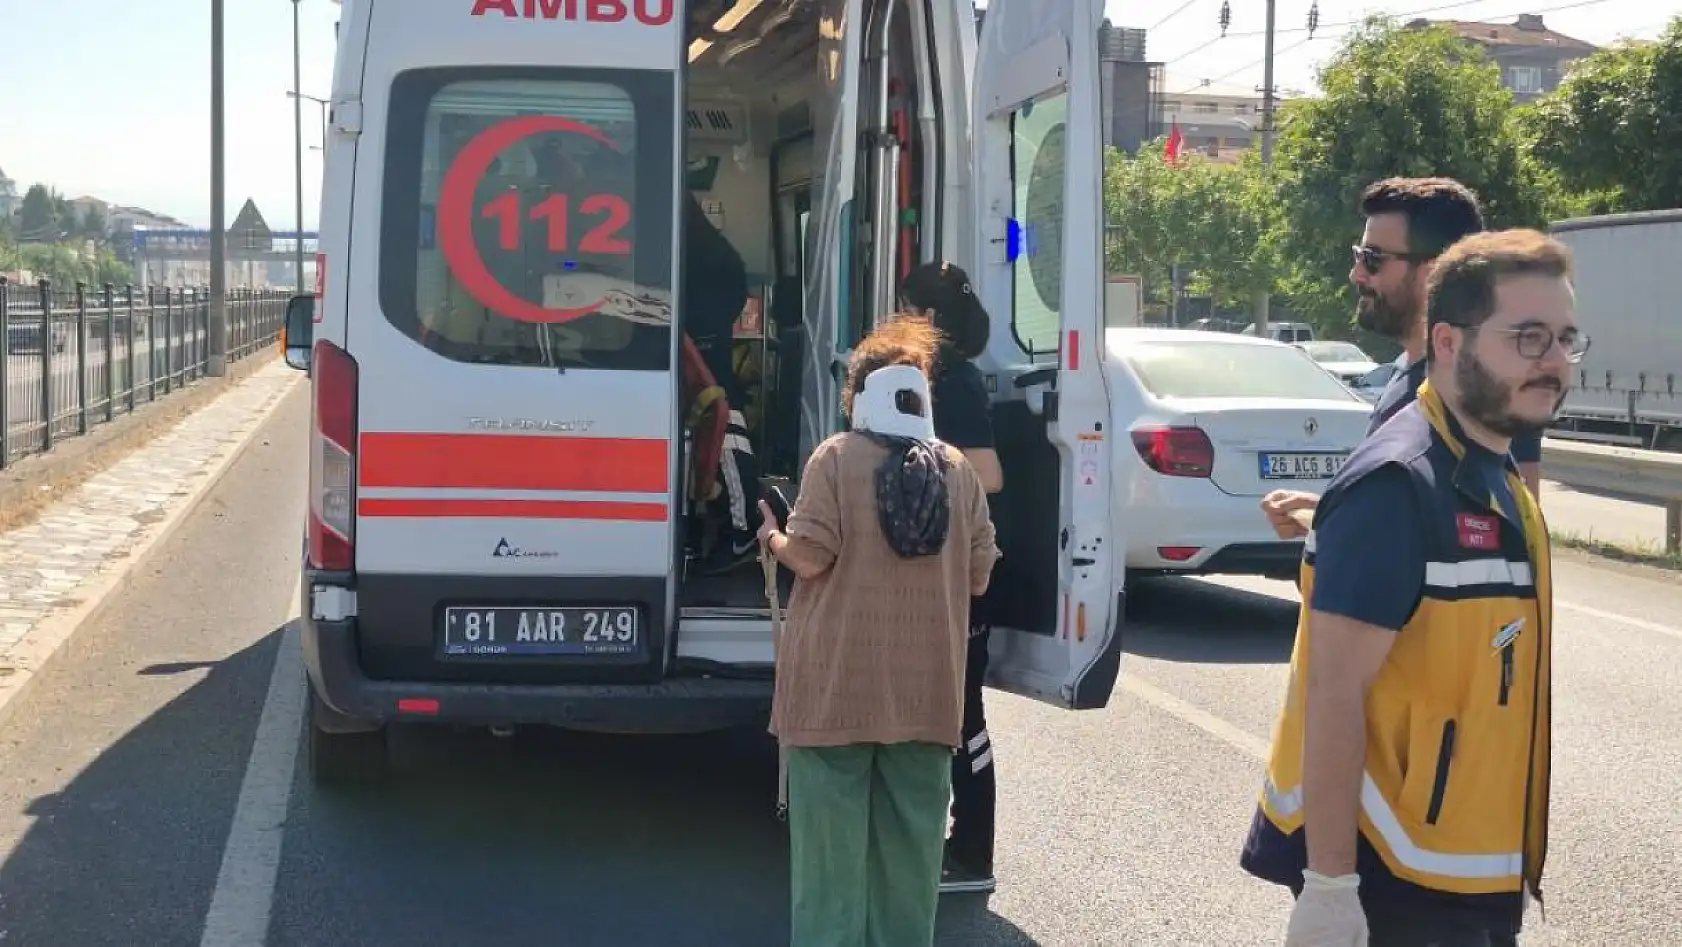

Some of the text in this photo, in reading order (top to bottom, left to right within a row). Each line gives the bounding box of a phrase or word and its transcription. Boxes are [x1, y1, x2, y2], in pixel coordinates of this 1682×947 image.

[481, 192, 632, 254] 112
[1271, 457, 1288, 472] 26
[465, 612, 632, 641] 81 AAR 249
